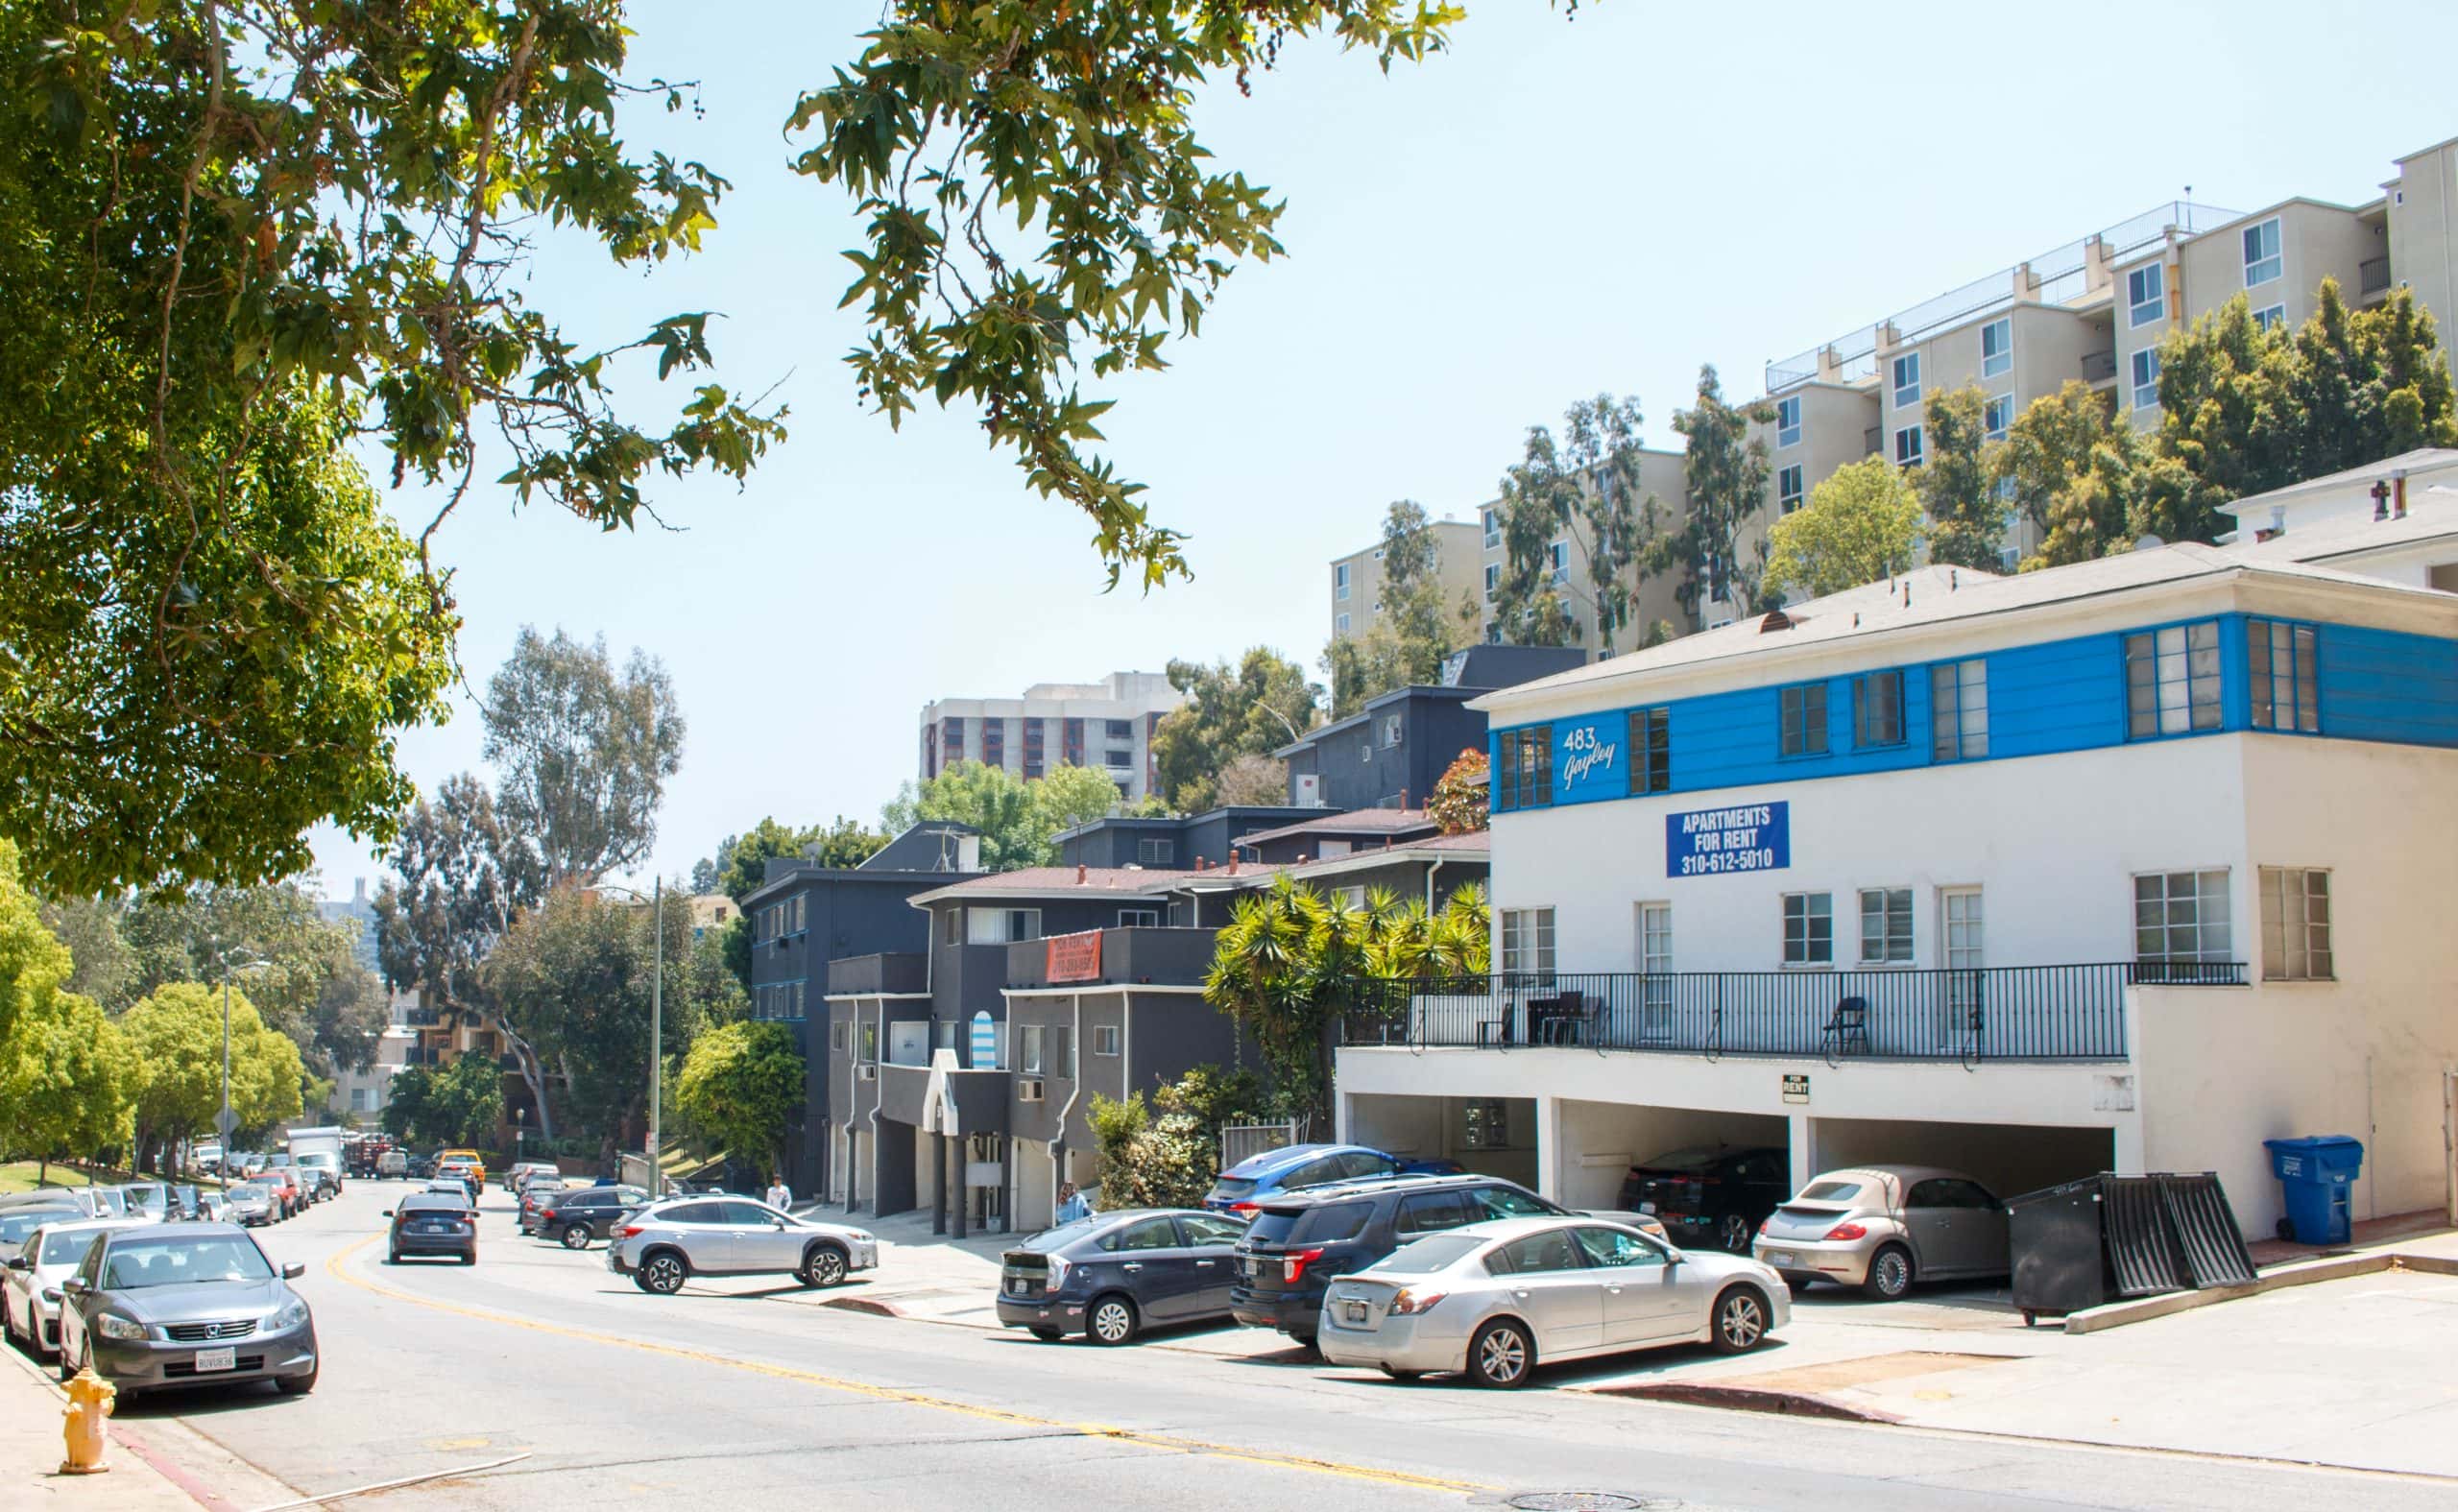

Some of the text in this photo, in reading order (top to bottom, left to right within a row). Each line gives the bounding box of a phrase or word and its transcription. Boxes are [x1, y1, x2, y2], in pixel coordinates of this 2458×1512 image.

[1563, 727, 1596, 752] 483
[1564, 743, 1616, 790] Gayley
[1682, 805, 1771, 834] APARTMENTS
[1695, 828, 1758, 852] FOR RENT
[1681, 848, 1772, 875] 310-612-5010
[1783, 1082, 1808, 1093] RENT
